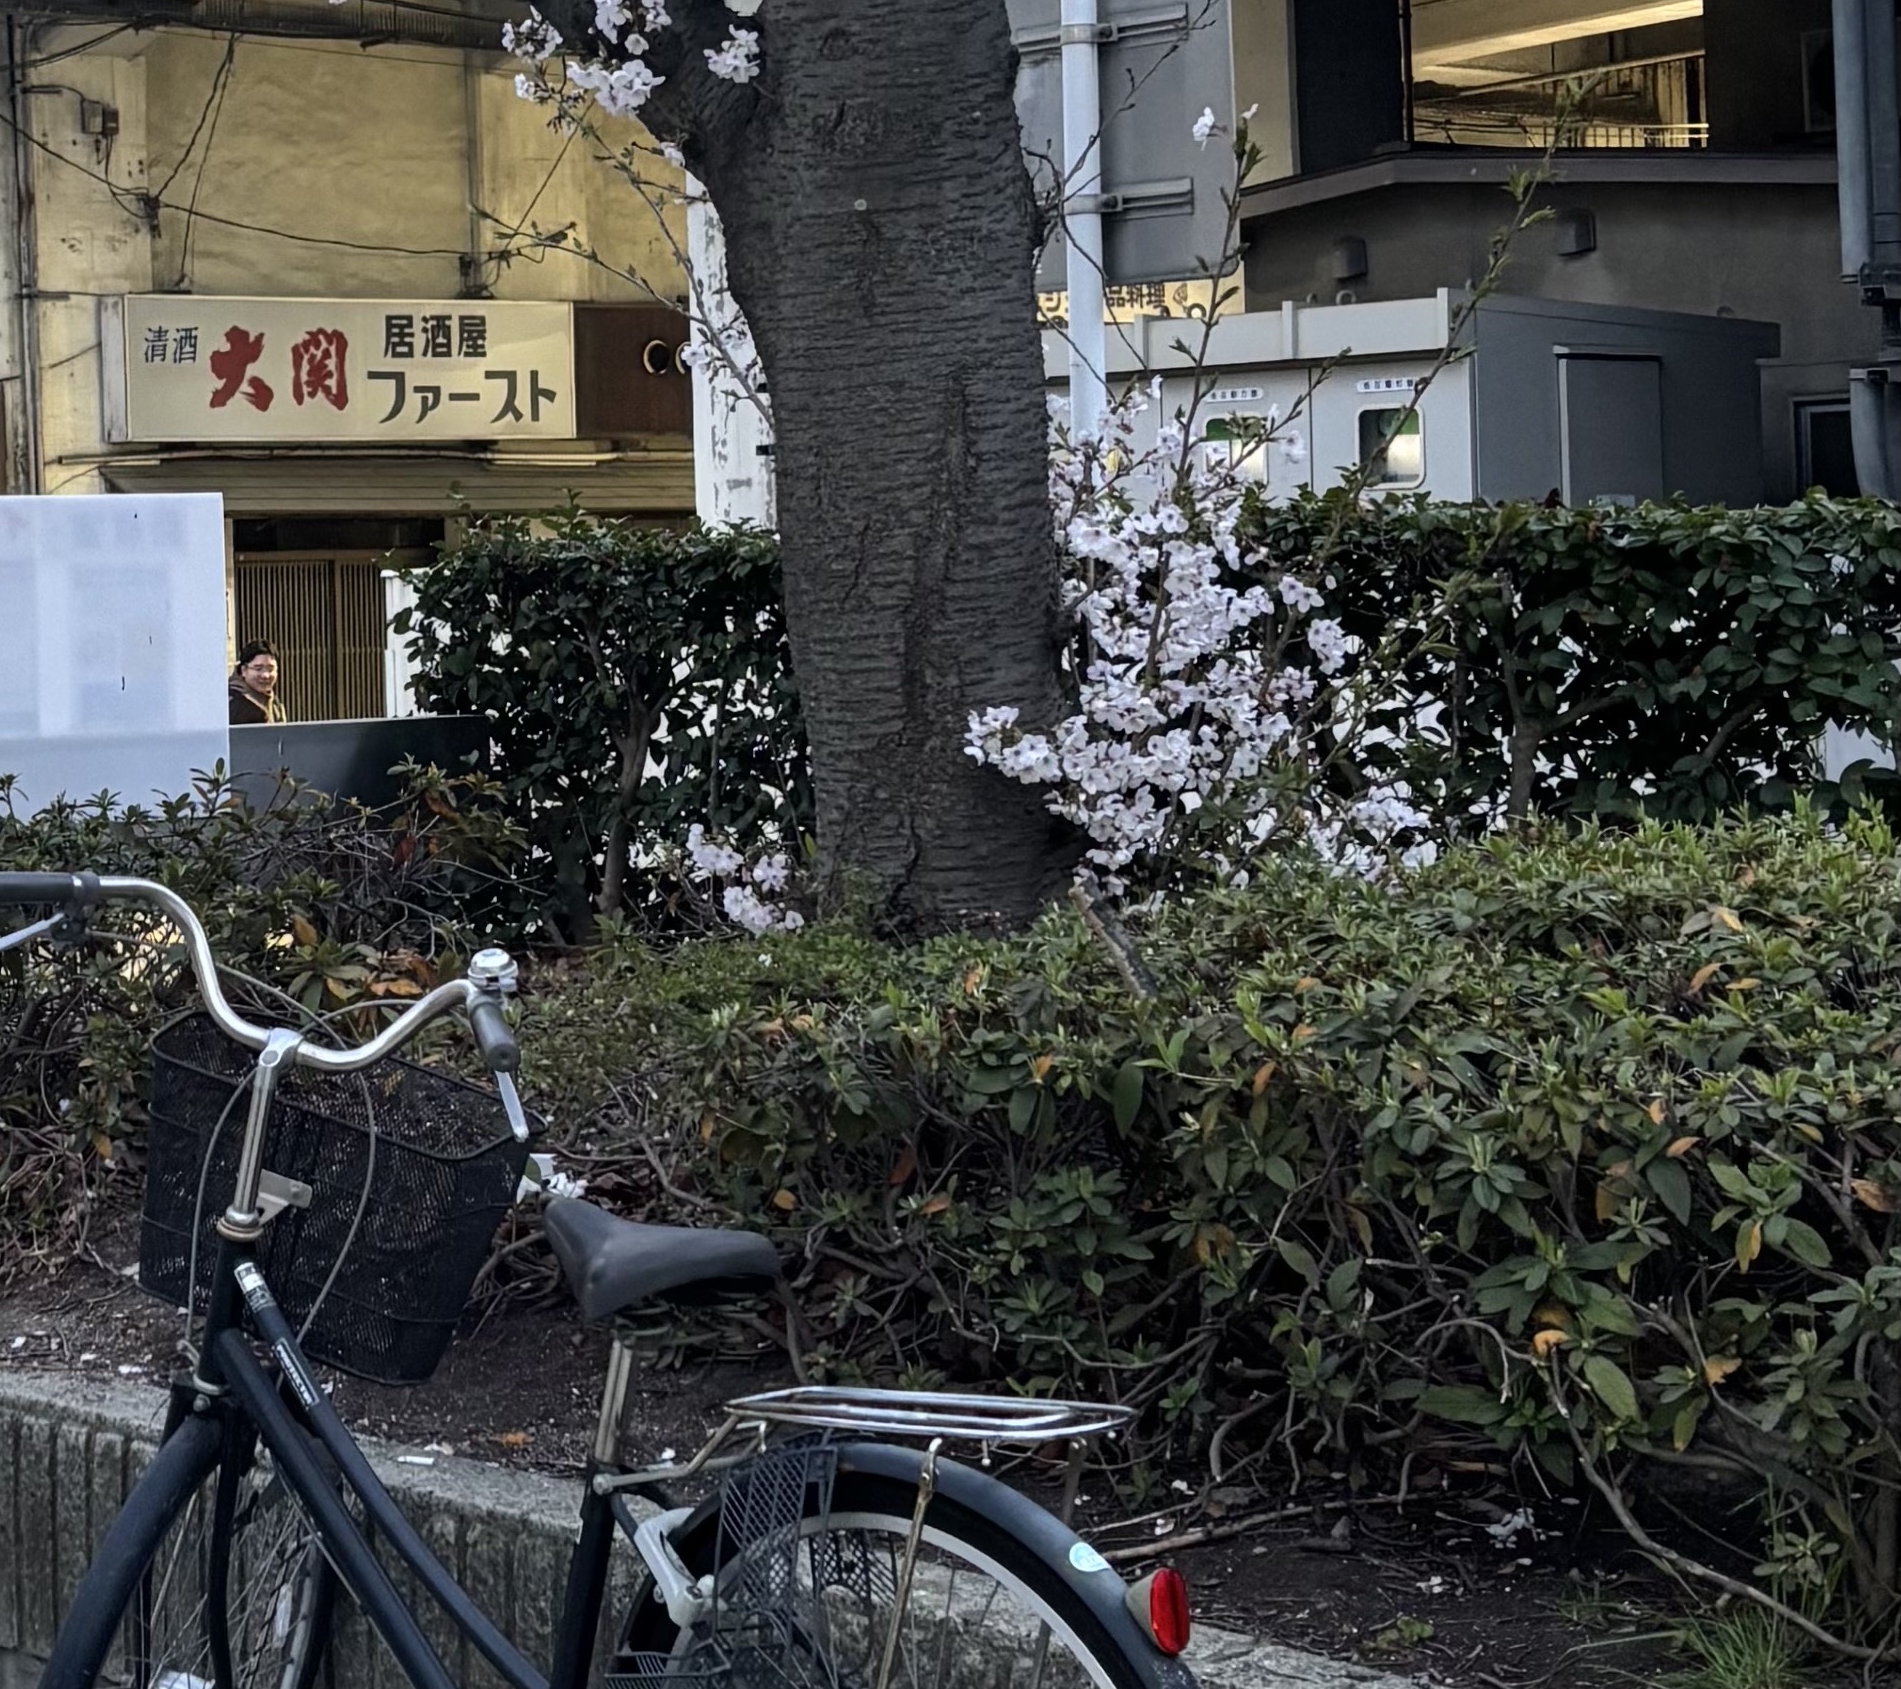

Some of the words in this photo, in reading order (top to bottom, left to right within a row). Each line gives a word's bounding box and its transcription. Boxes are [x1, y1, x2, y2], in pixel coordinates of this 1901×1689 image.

[383, 315, 488, 359] 居酒屋
[144, 326, 199, 363] 清酒
[209, 325, 349, 412] 大関
[366, 370, 557, 424] ファースト
